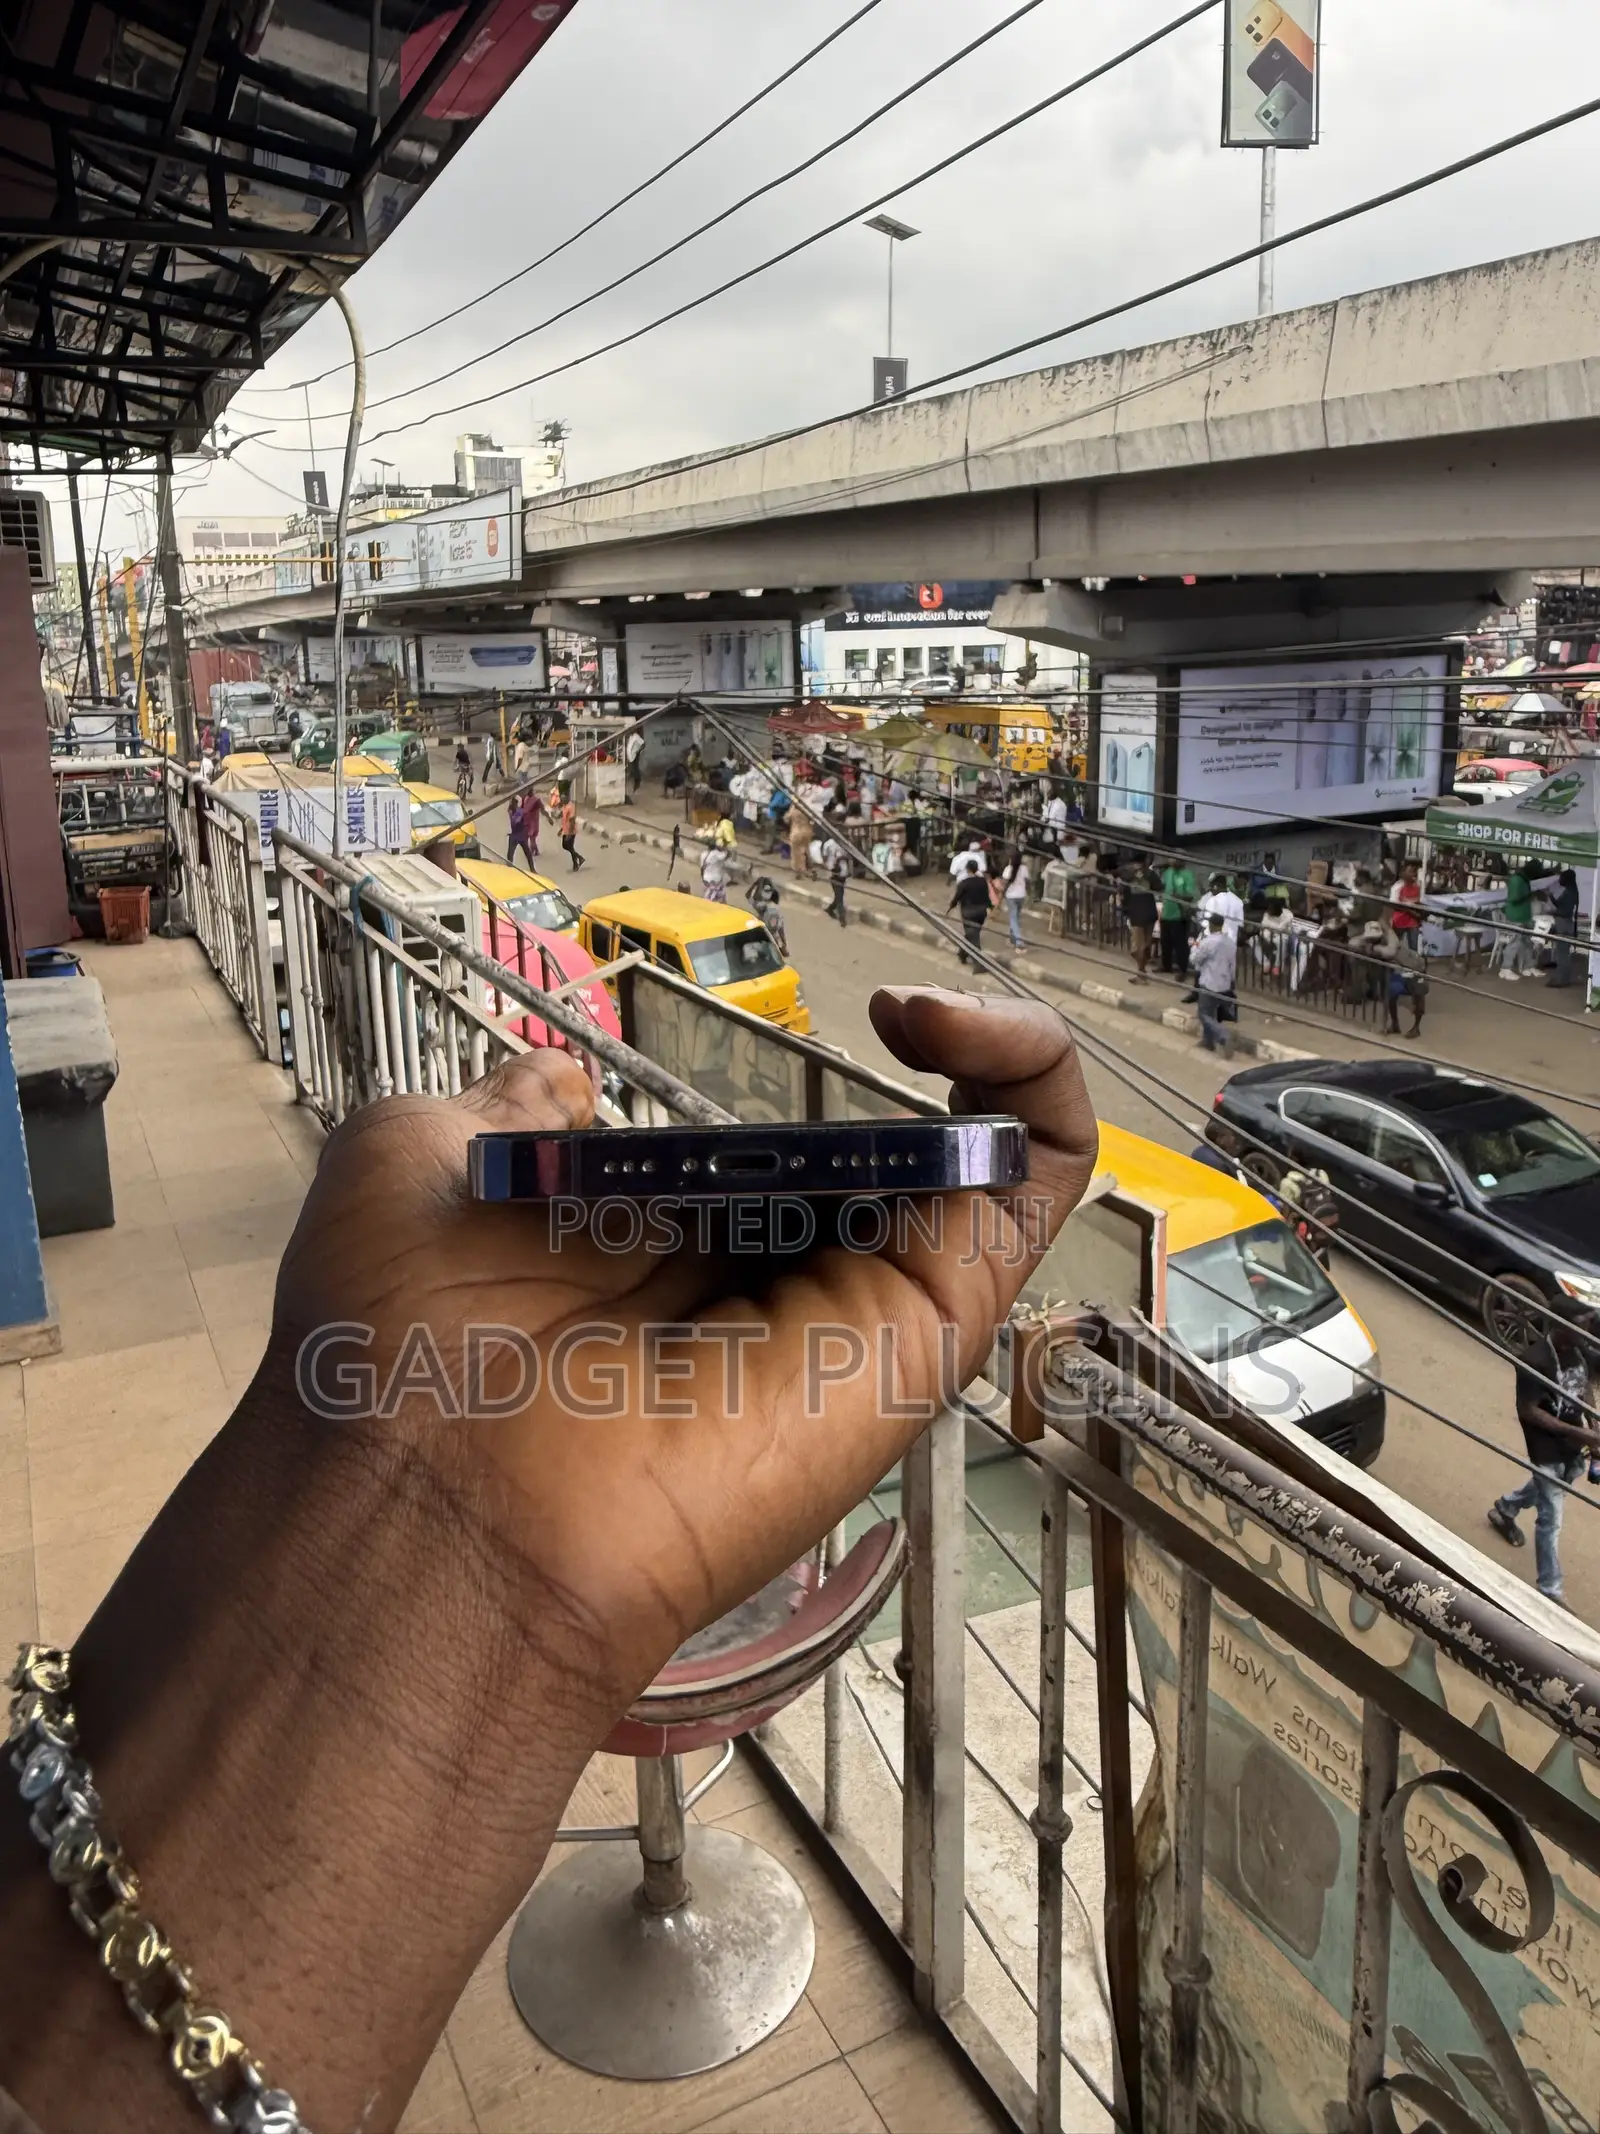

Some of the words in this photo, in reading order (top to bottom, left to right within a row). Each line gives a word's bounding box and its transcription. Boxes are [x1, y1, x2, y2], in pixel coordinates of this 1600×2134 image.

[1456, 822, 1492, 839] SHOP
[1494, 827, 1521, 846] FOR
[1524, 832, 1559, 850] FREE
